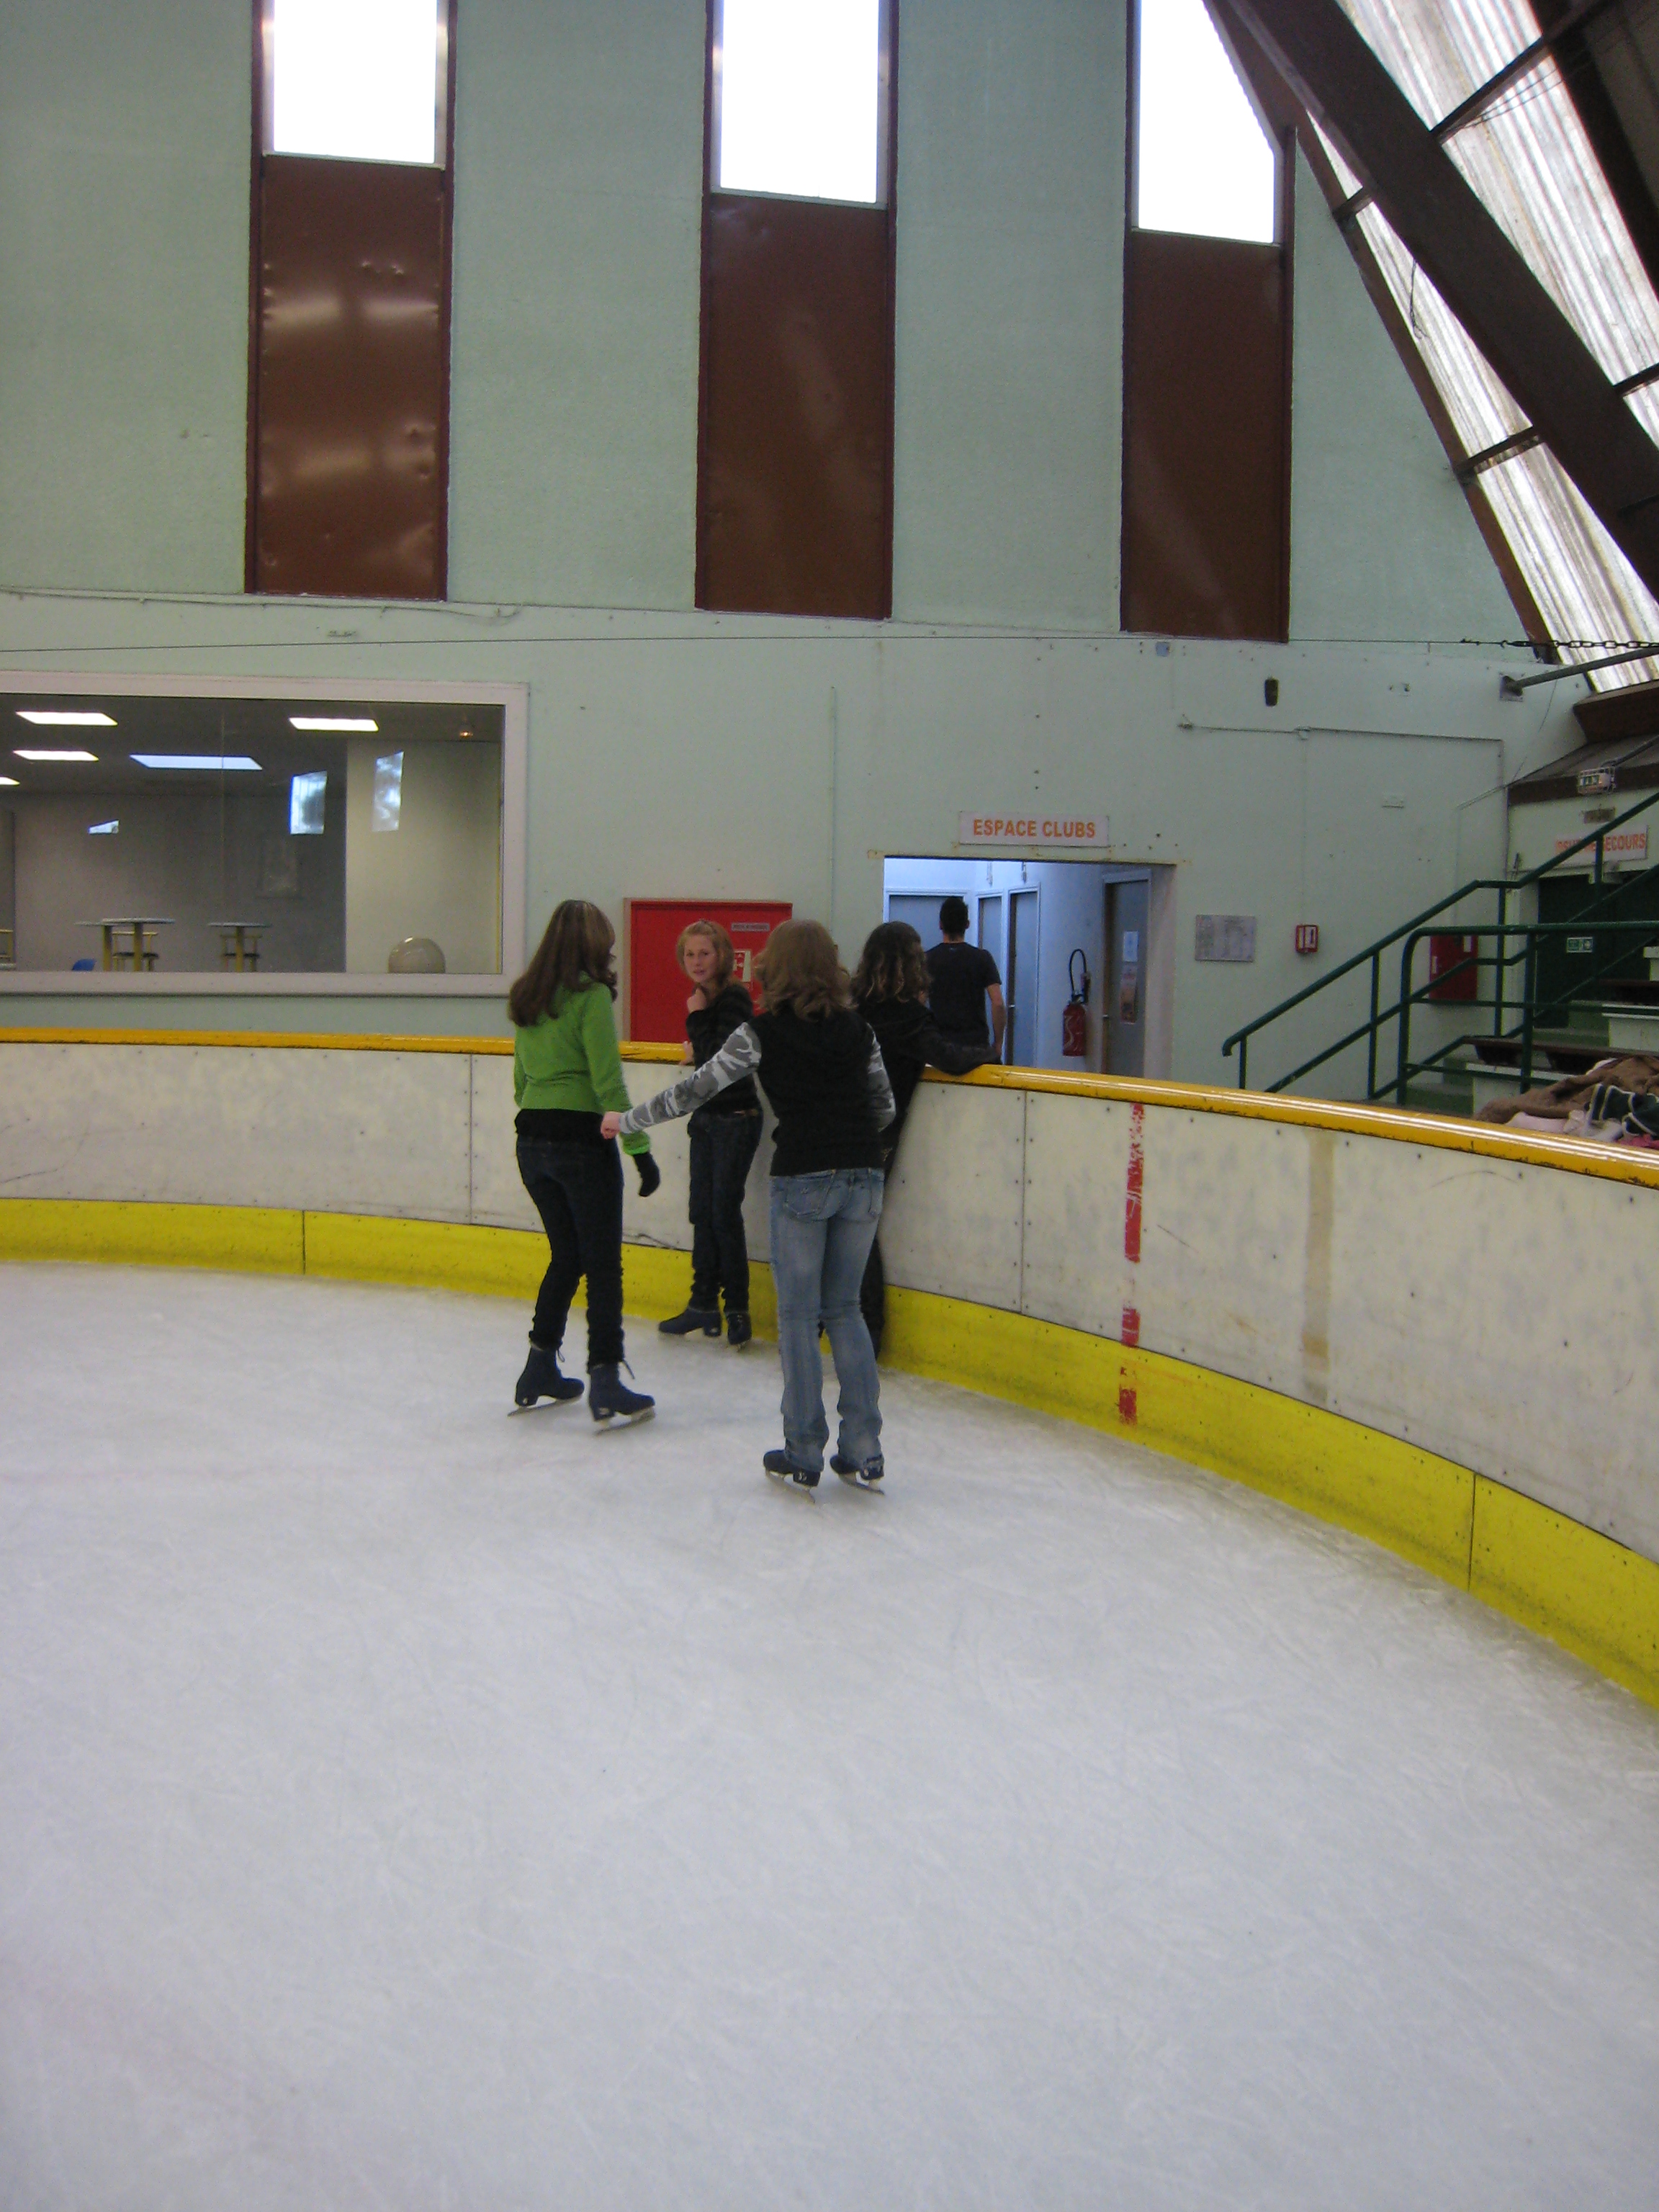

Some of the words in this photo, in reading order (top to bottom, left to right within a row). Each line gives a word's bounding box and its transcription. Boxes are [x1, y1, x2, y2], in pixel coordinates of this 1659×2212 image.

[974, 819, 1037, 836] ESPACE
[1042, 821, 1096, 838] CLUBS
[1603, 833, 1646, 853] ECOURS
